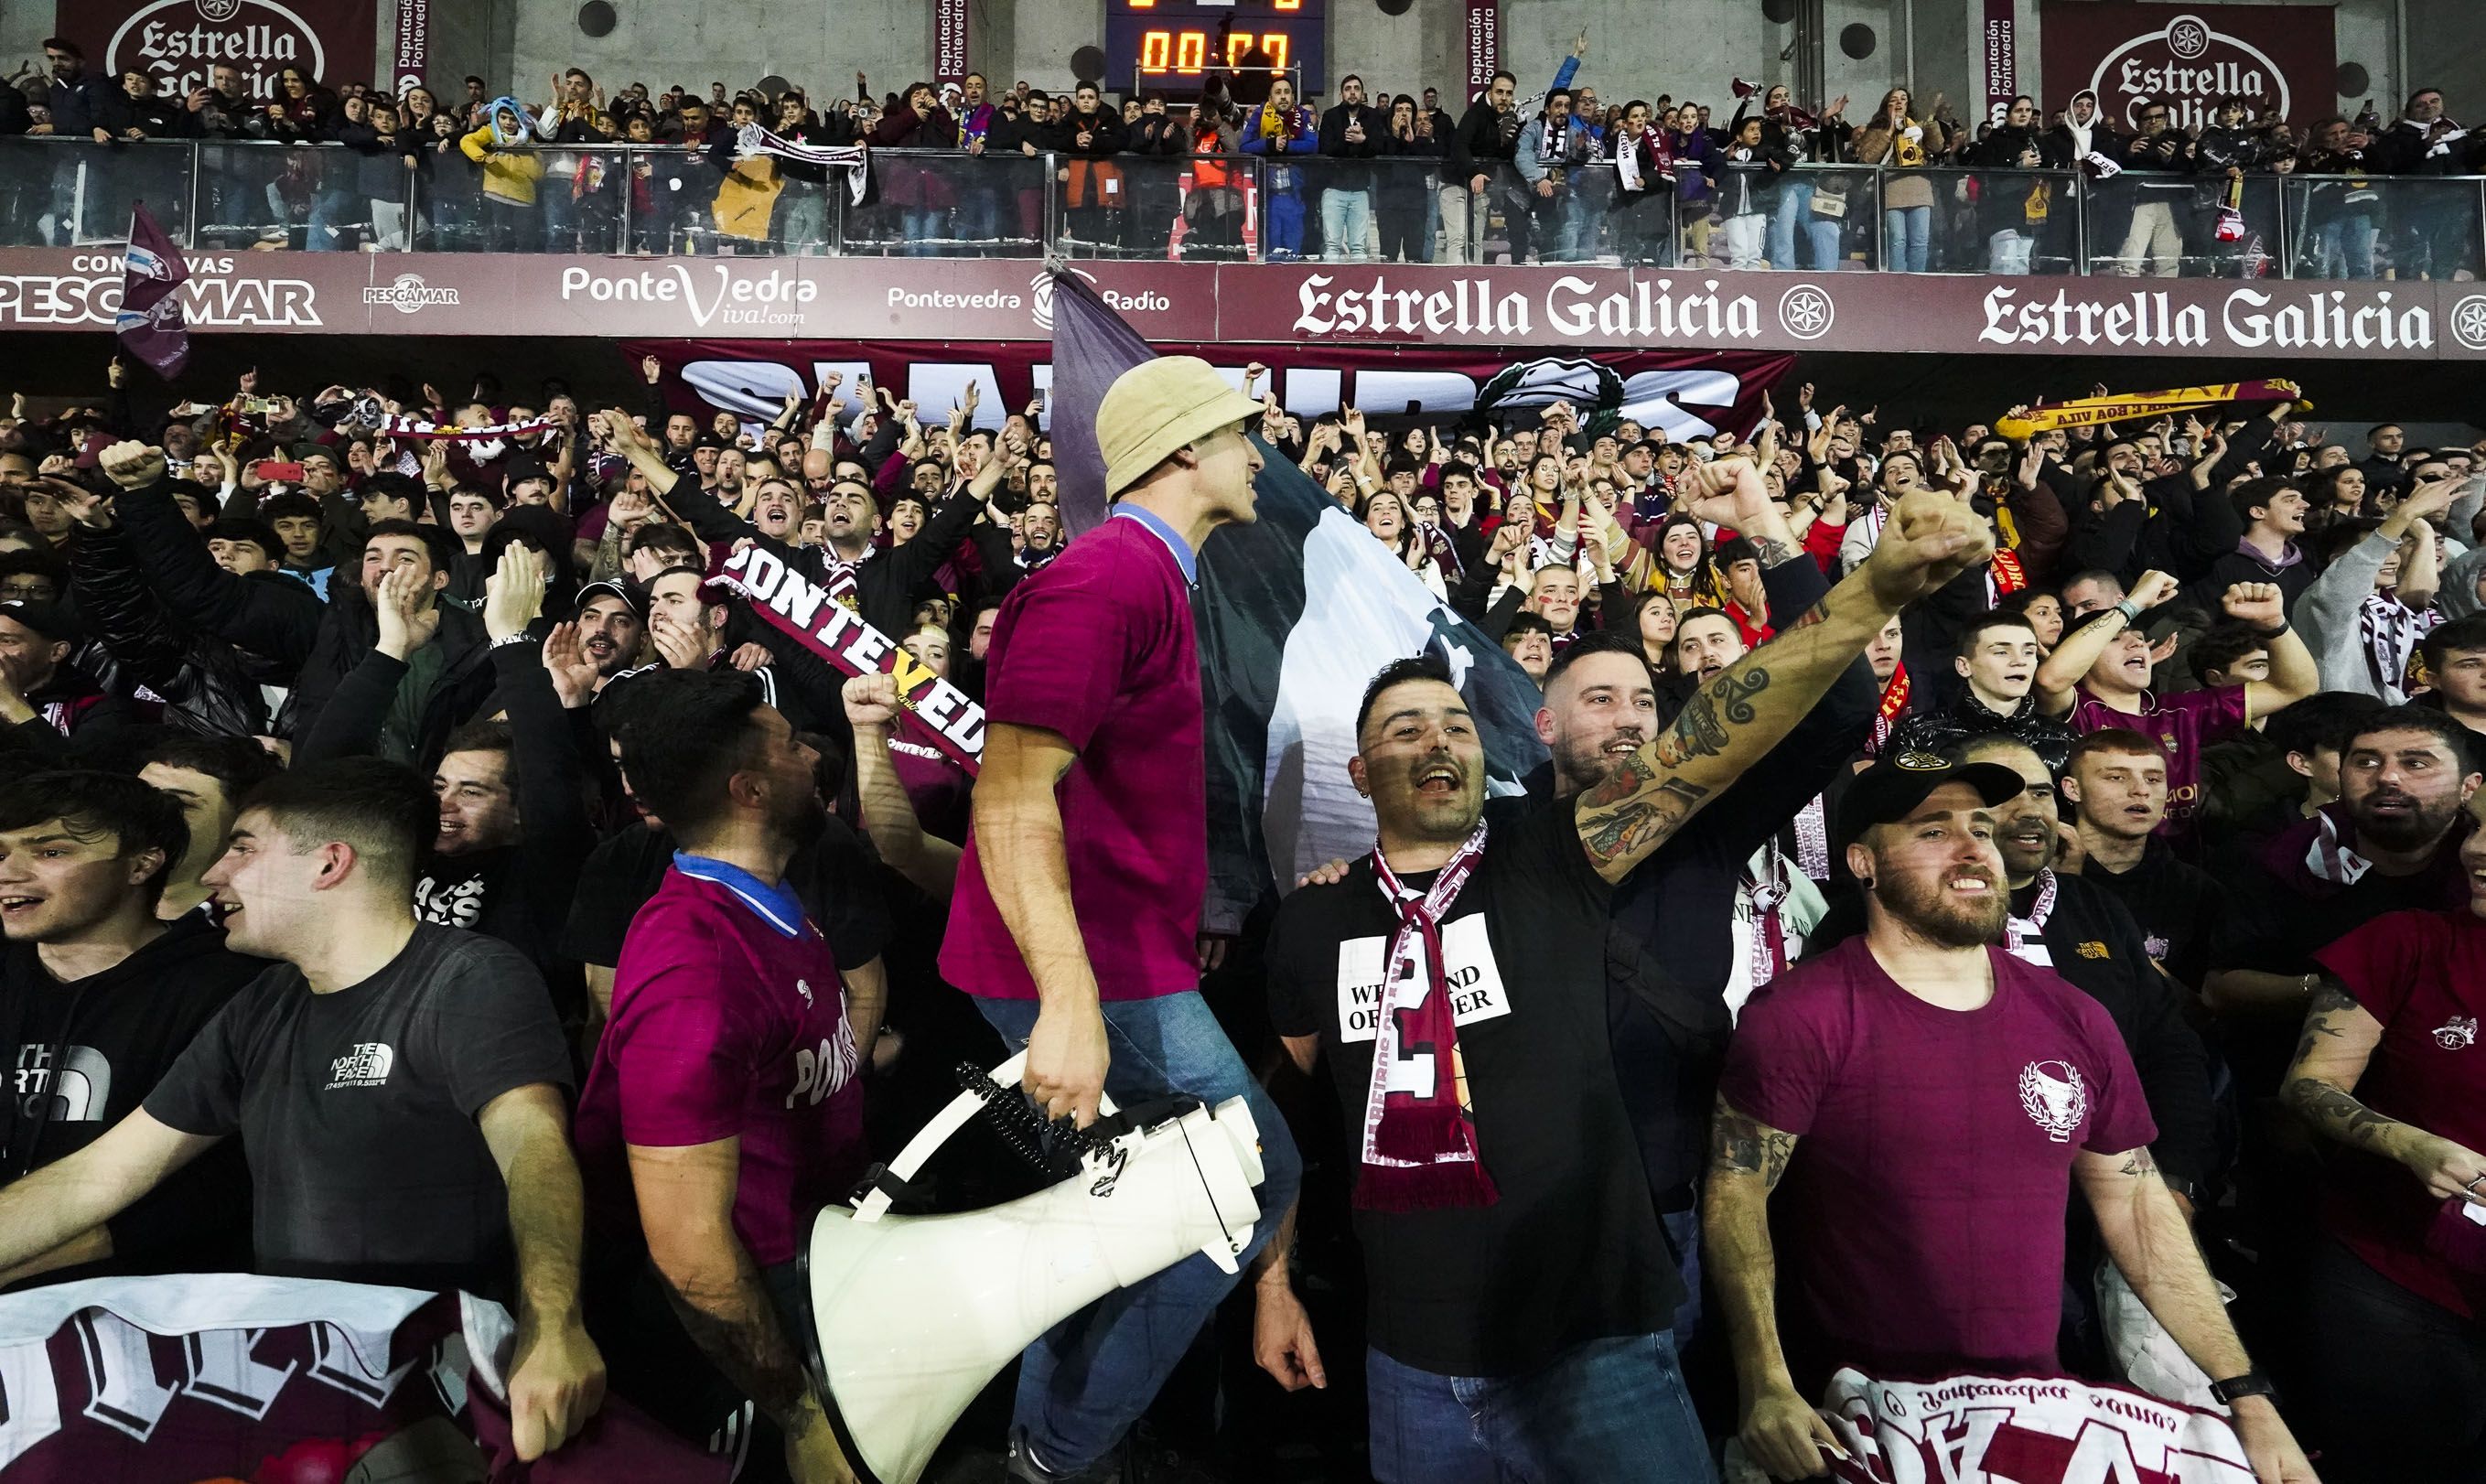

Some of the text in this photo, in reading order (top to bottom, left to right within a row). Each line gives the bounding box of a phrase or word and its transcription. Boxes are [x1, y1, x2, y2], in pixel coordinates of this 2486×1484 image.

[138, 20, 297, 60] Estrella
[399, 0, 414, 67] Deputació
[412, 0, 425, 67] Pontevedr
[939, 0, 953, 75] Deputación
[952, 0, 964, 75] Pontevedra
[1469, 8, 1484, 84] Deputación
[1483, 8, 1494, 84] Pontevedra
[1986, 20, 2003, 95] Deputación
[2001, 20, 2012, 96] Pontevedra
[2118, 59, 2264, 97] Estrella
[72, 255, 234, 274] CONVAS
[363, 286, 459, 305] PESCAMAR
[0, 276, 324, 326] PESCMAR
[888, 287, 1021, 308] Pontevedra
[1102, 290, 1170, 311] Radio
[1292, 273, 1761, 339] Estrella Galicia
[1978, 285, 2434, 349] Estrella Galicia
[330, 1054, 374, 1071] NORTH
[334, 1066, 370, 1081] FACE
